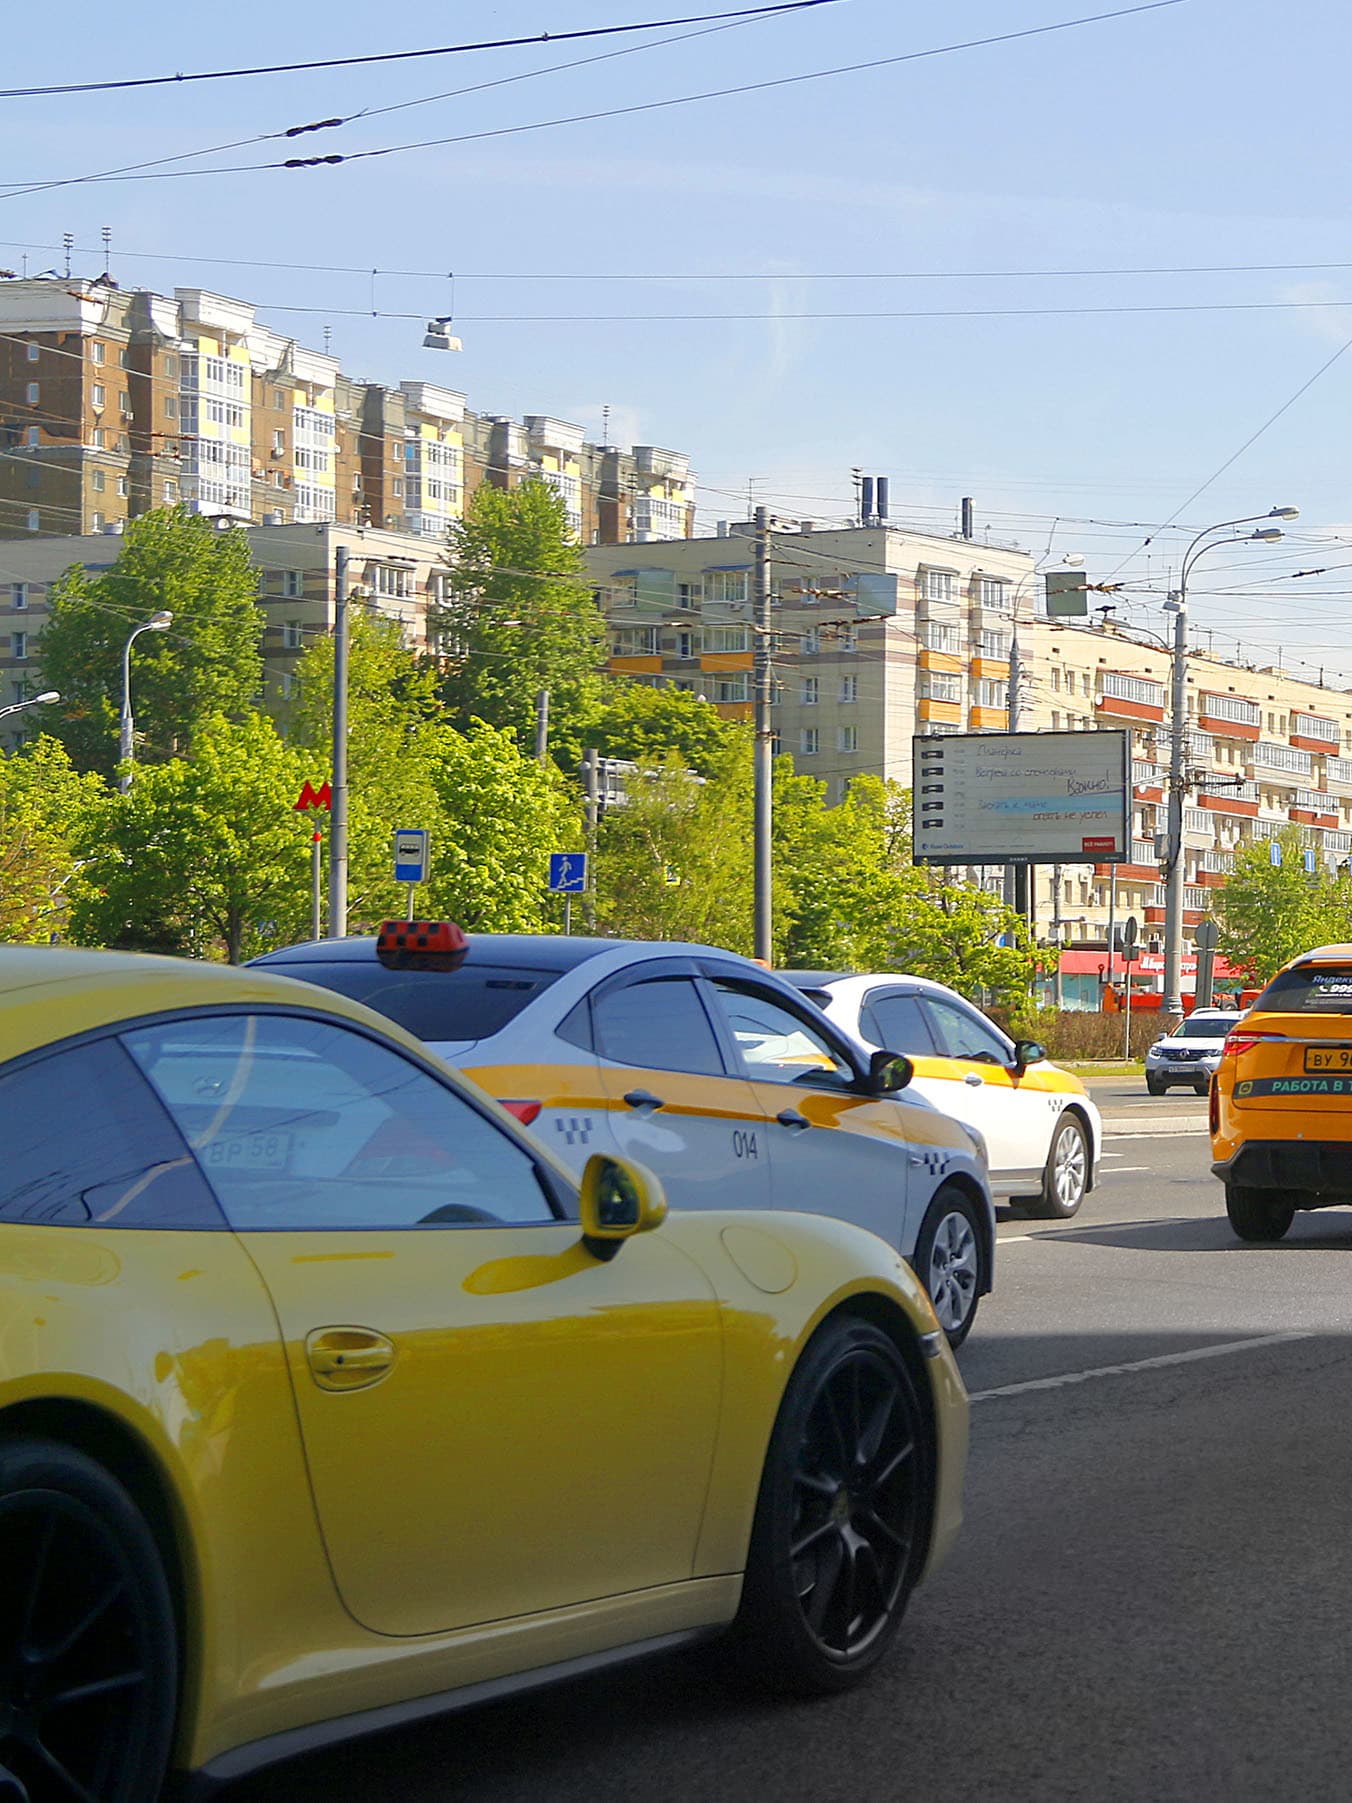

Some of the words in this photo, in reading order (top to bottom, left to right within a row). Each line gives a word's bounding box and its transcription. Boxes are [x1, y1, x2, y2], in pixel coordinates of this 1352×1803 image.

[292, 780, 332, 811] М
[1313, 1054, 1333, 1067] ВУ
[1271, 1080, 1328, 1093] РАБОТА
[1333, 1080, 1343, 1091] В
[733, 1131, 759, 1159] 014
